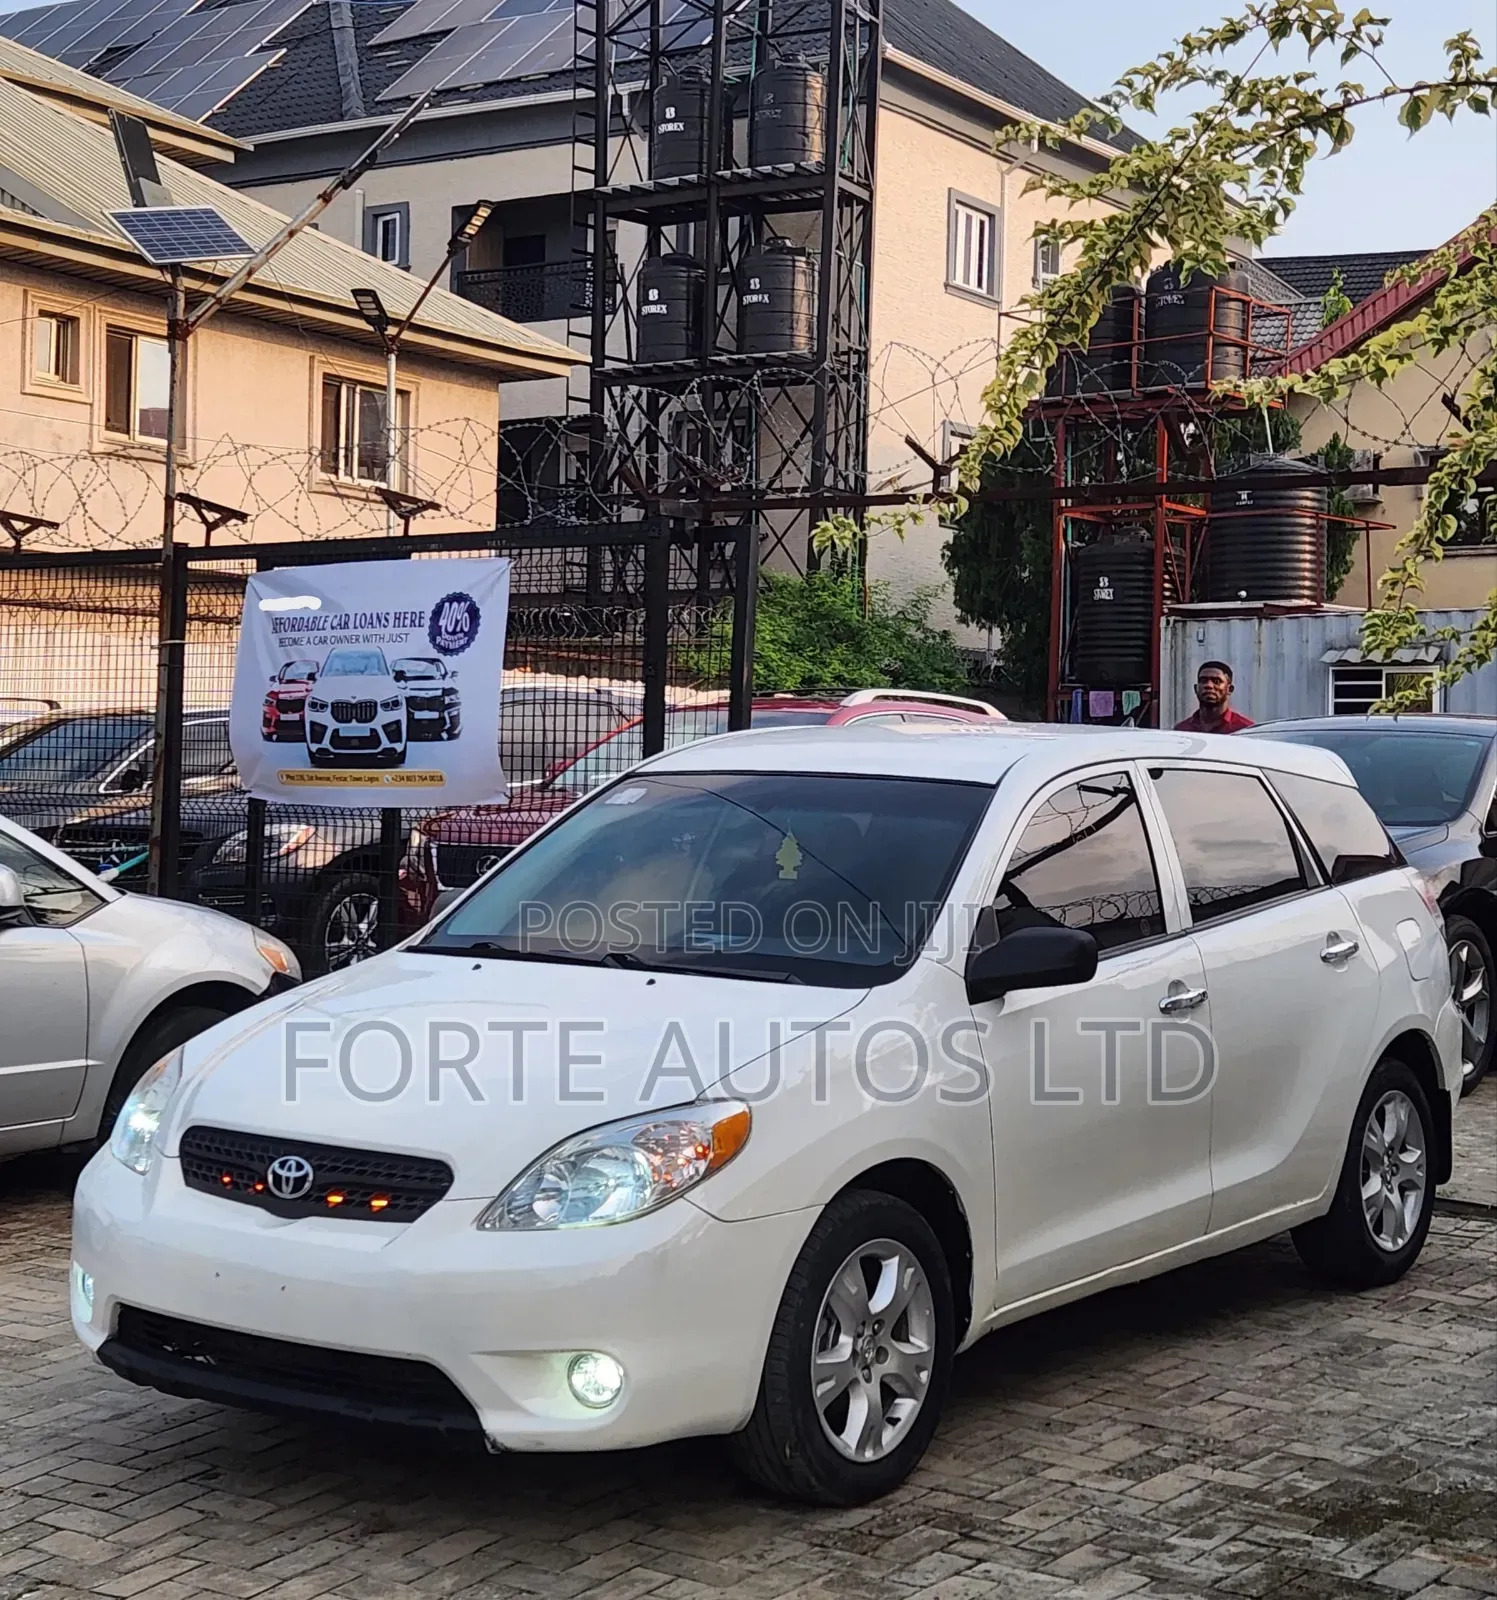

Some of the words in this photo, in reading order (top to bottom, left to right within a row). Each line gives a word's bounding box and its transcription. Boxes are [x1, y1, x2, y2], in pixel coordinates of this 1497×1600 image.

[330, 613, 350, 630] CAR
[353, 612, 390, 630] LOANS
[392, 611, 425, 628] HERE
[438, 601, 470, 632] 40%
[305, 636, 312, 646] A
[312, 635, 329, 646] CAR
[329, 634, 361, 645] OWNER
[362, 633, 385, 644] WITH
[386, 632, 410, 644] JUST
